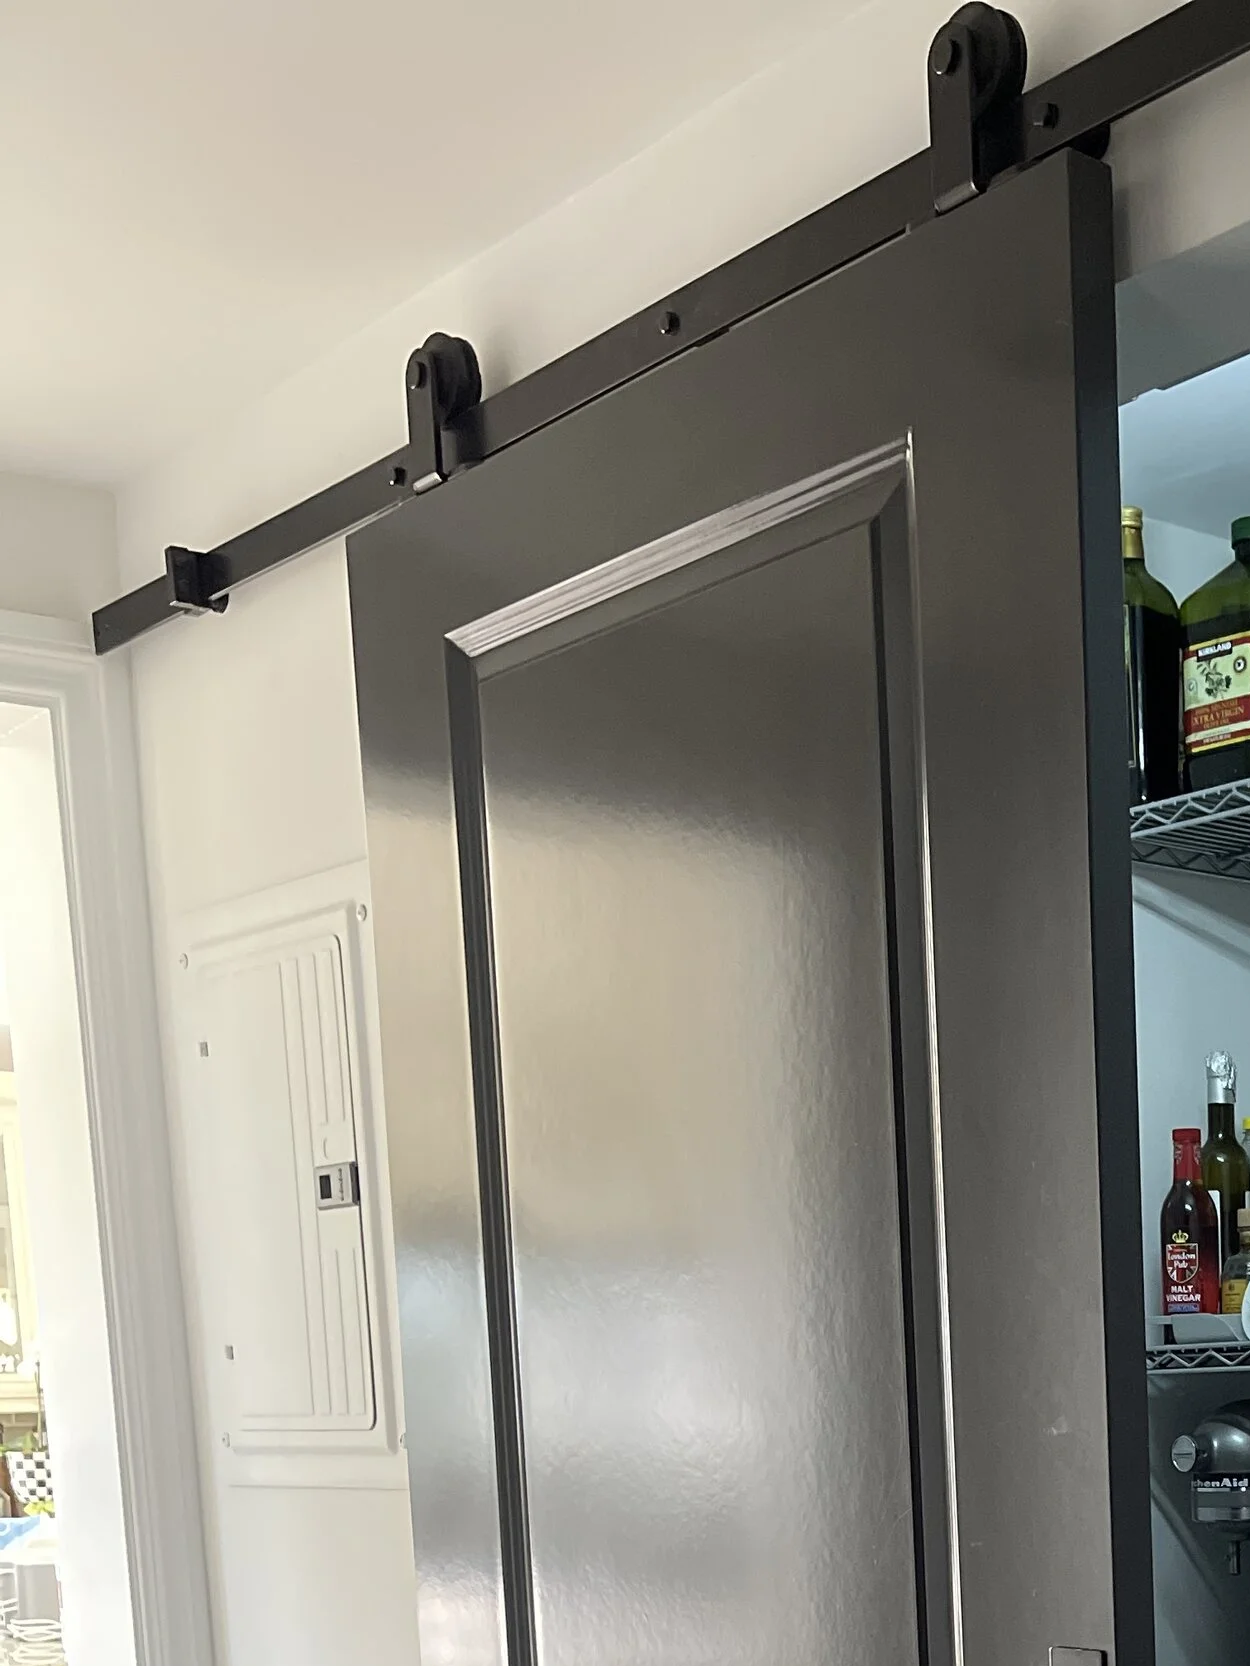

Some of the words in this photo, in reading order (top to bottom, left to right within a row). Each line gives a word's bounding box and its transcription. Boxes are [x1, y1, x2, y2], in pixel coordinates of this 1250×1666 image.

[1166, 1251, 1196, 1261] London
[1174, 1260, 1189, 1269] Pub
[1171, 1285, 1194, 1294] MALT
[1166, 1293, 1201, 1302] VINEGAR
